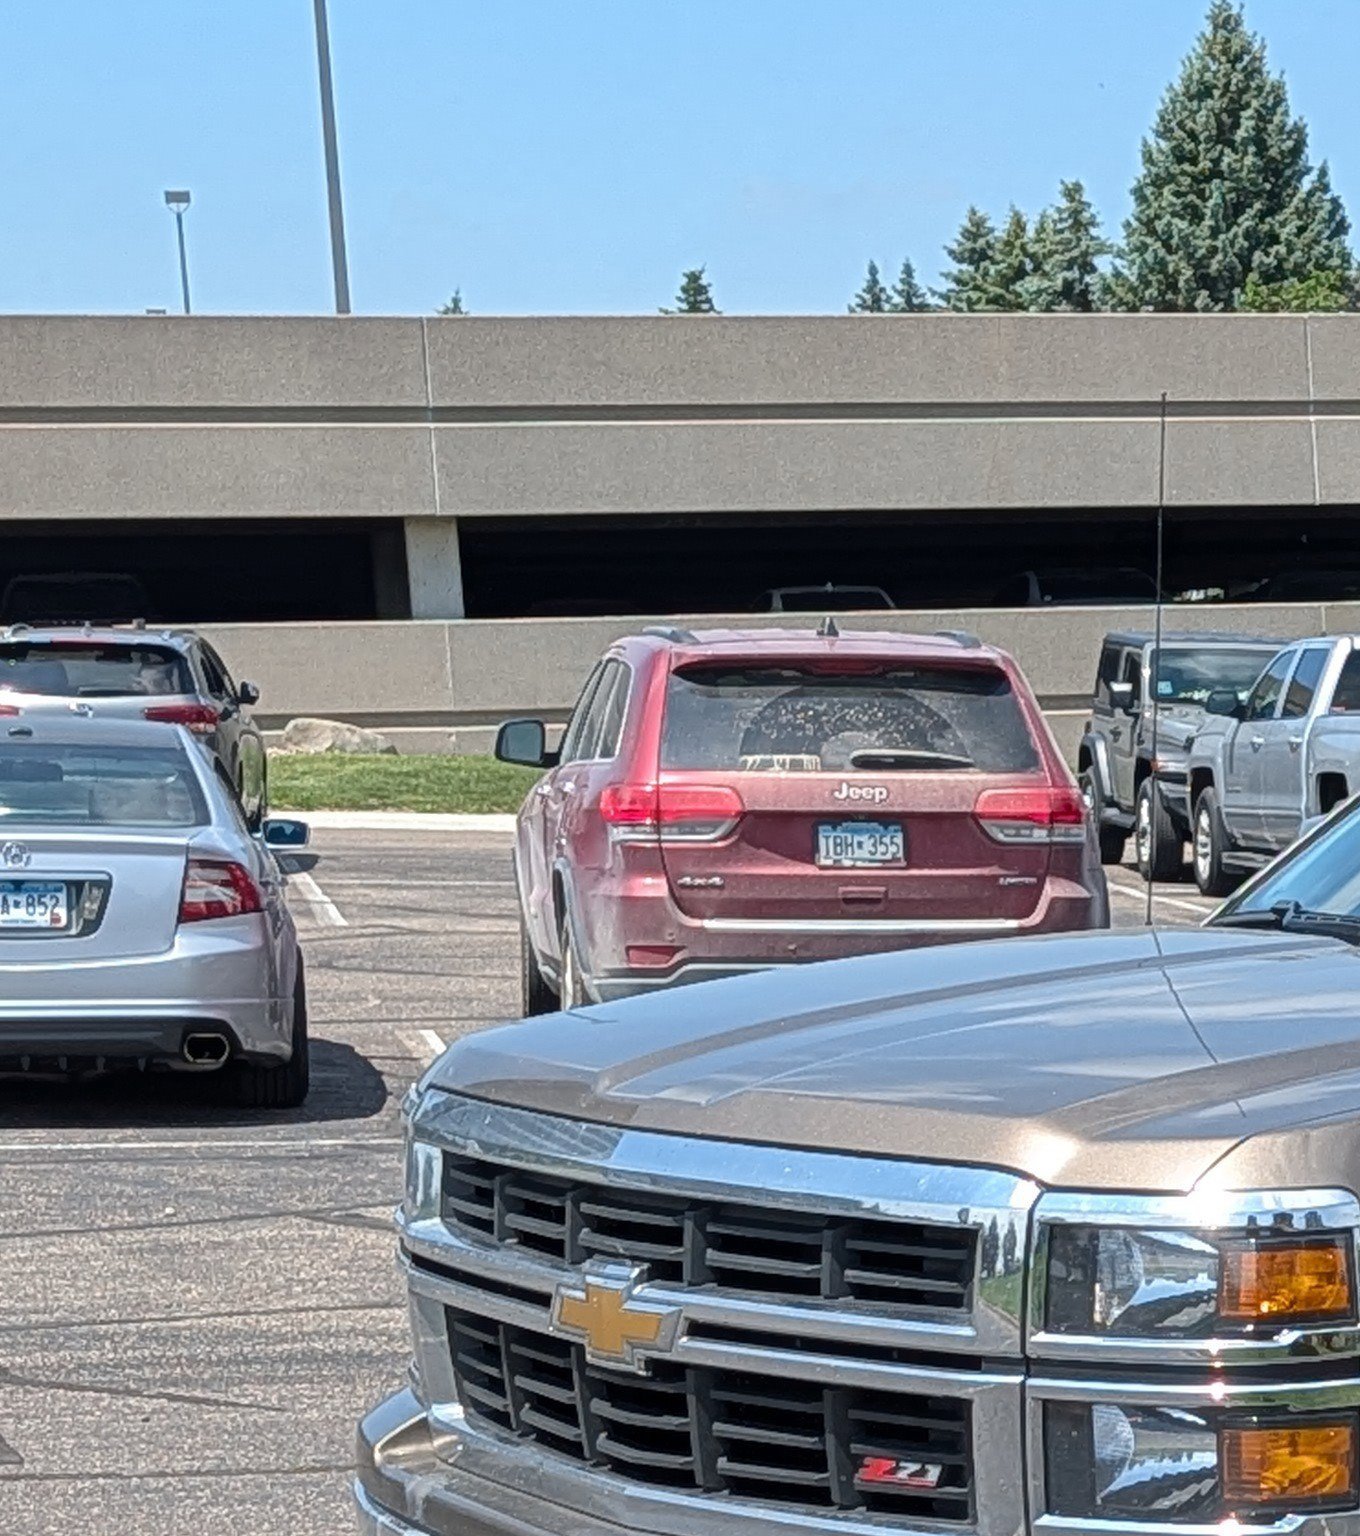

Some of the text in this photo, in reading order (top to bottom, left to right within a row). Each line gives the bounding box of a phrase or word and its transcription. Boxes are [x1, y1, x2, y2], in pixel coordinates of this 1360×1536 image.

[833, 782, 889, 803] Jeep
[868, 834, 900, 857] 355
[857, 1457, 942, 1487] Z71
